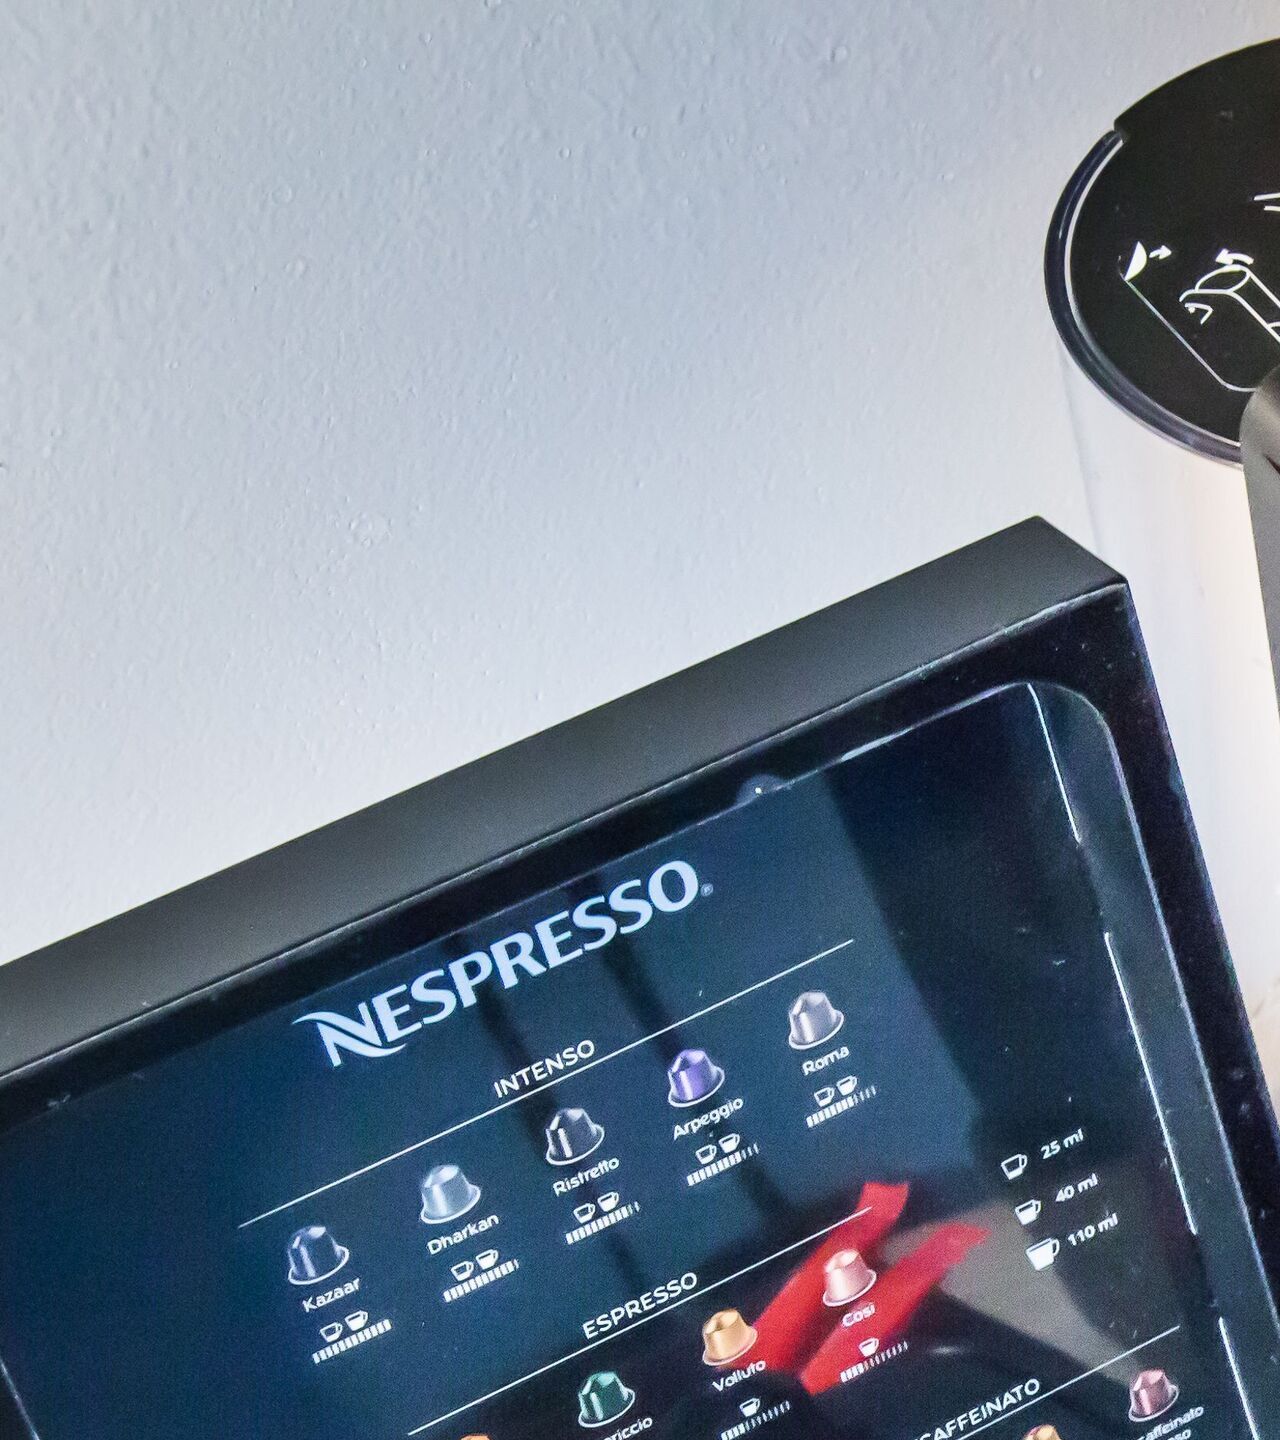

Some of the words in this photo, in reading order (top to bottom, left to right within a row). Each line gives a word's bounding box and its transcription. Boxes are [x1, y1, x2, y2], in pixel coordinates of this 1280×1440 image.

[494, 1040, 595, 1098] INTENSO
[803, 1045, 849, 1075] Roma
[672, 1098, 744, 1139] Arpeggio
[1041, 1139, 1061, 1160] 25
[1063, 1130, 1084, 1151] ml
[553, 1158, 620, 1197] Ristretto
[1055, 1183, 1075, 1203] 40
[1077, 1174, 1099, 1195] ml
[427, 1214, 499, 1254] Dharkan
[1068, 1225, 1095, 1247] 110
[1097, 1214, 1118, 1236] ml
[303, 1278, 361, 1312] Kazaar
[583, 1273, 697, 1339] ESPRESSO
[842, 1303, 876, 1328] Cosi
[712, 1362, 767, 1393] Volluto
